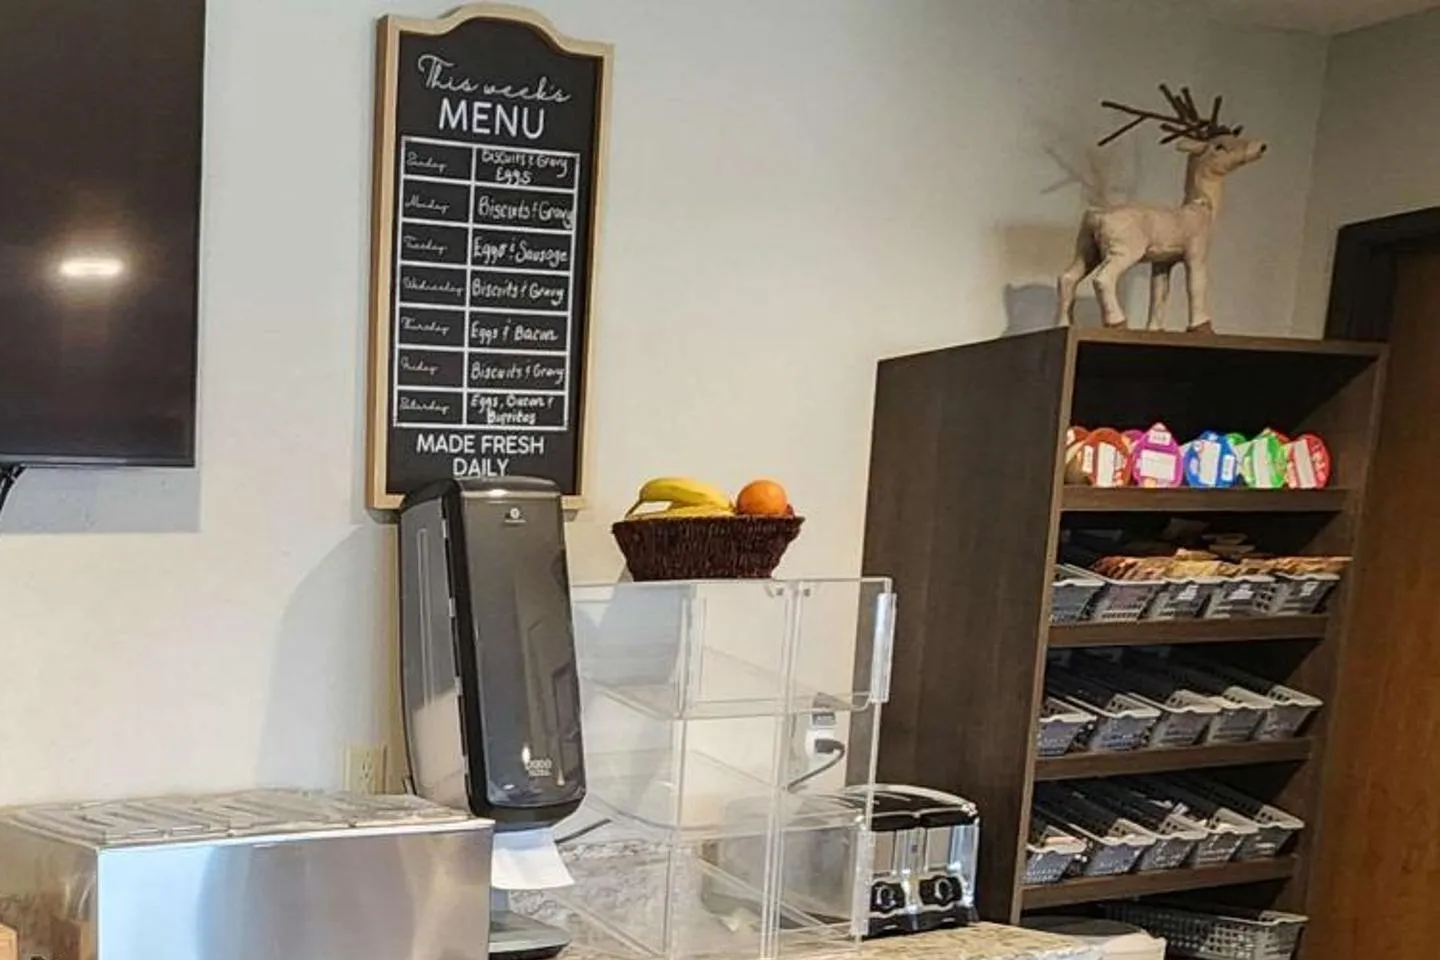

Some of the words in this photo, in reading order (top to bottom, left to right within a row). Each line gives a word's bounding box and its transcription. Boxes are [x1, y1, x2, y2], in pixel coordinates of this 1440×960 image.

[418, 54, 479, 92] This
[439, 97, 544, 139] MENU
[495, 167, 532, 185] Eggs
[478, 195, 530, 220] Biscuits
[538, 200, 574, 229] Gravy
[474, 236, 507, 264] Eggs
[515, 239, 568, 268] Sausage
[471, 278, 519, 298] Biscuits
[529, 282, 565, 306] Gravy
[471, 320, 498, 345] Eggs
[514, 325, 558, 341] Bacon
[471, 361, 523, 380] Biscuits
[533, 362, 565, 385] Gravy
[416, 433, 476, 454] MADE
[481, 435, 544, 454] FRESH
[453, 458, 510, 477] DAILY
